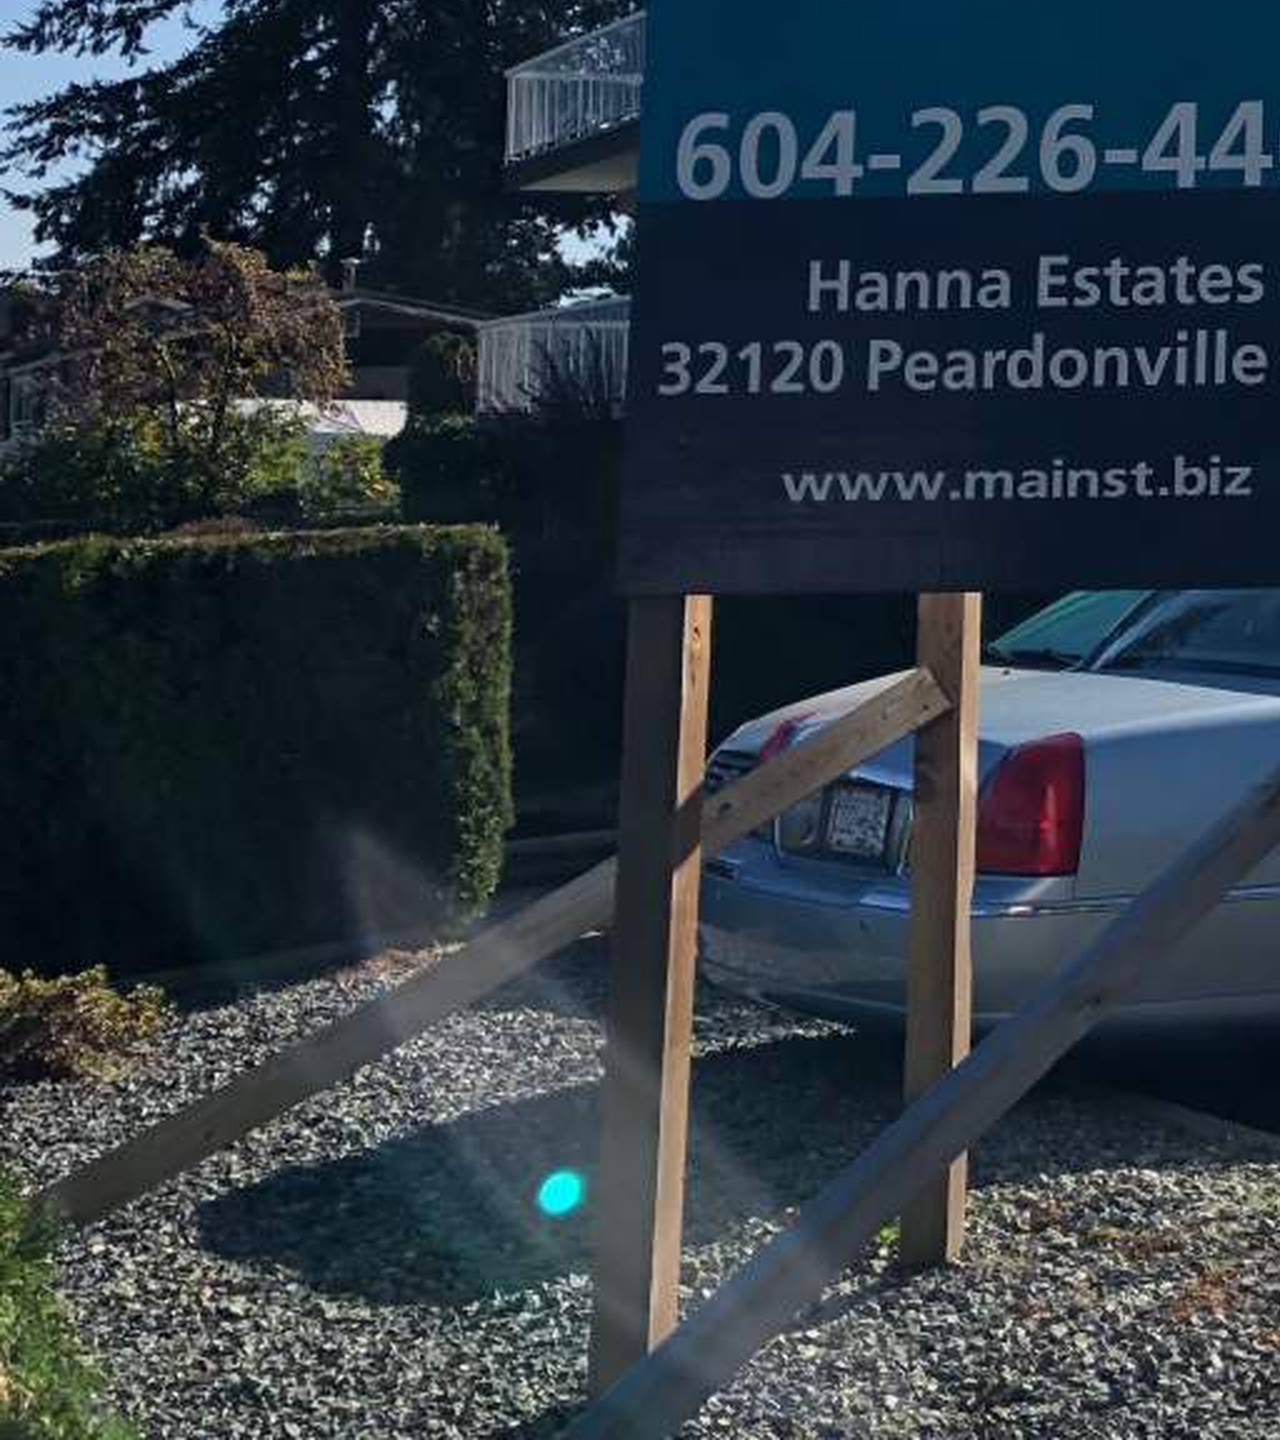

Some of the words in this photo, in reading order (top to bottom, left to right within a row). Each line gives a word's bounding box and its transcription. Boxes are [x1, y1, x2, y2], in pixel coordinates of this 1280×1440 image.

[807, 259, 1011, 312] Hanna
[1036, 255, 1264, 307] Estates
[657, 340, 844, 396] 32120
[867, 328, 1268, 392] Peardonville
[781, 455, 1253, 503] www.mainst.biz
